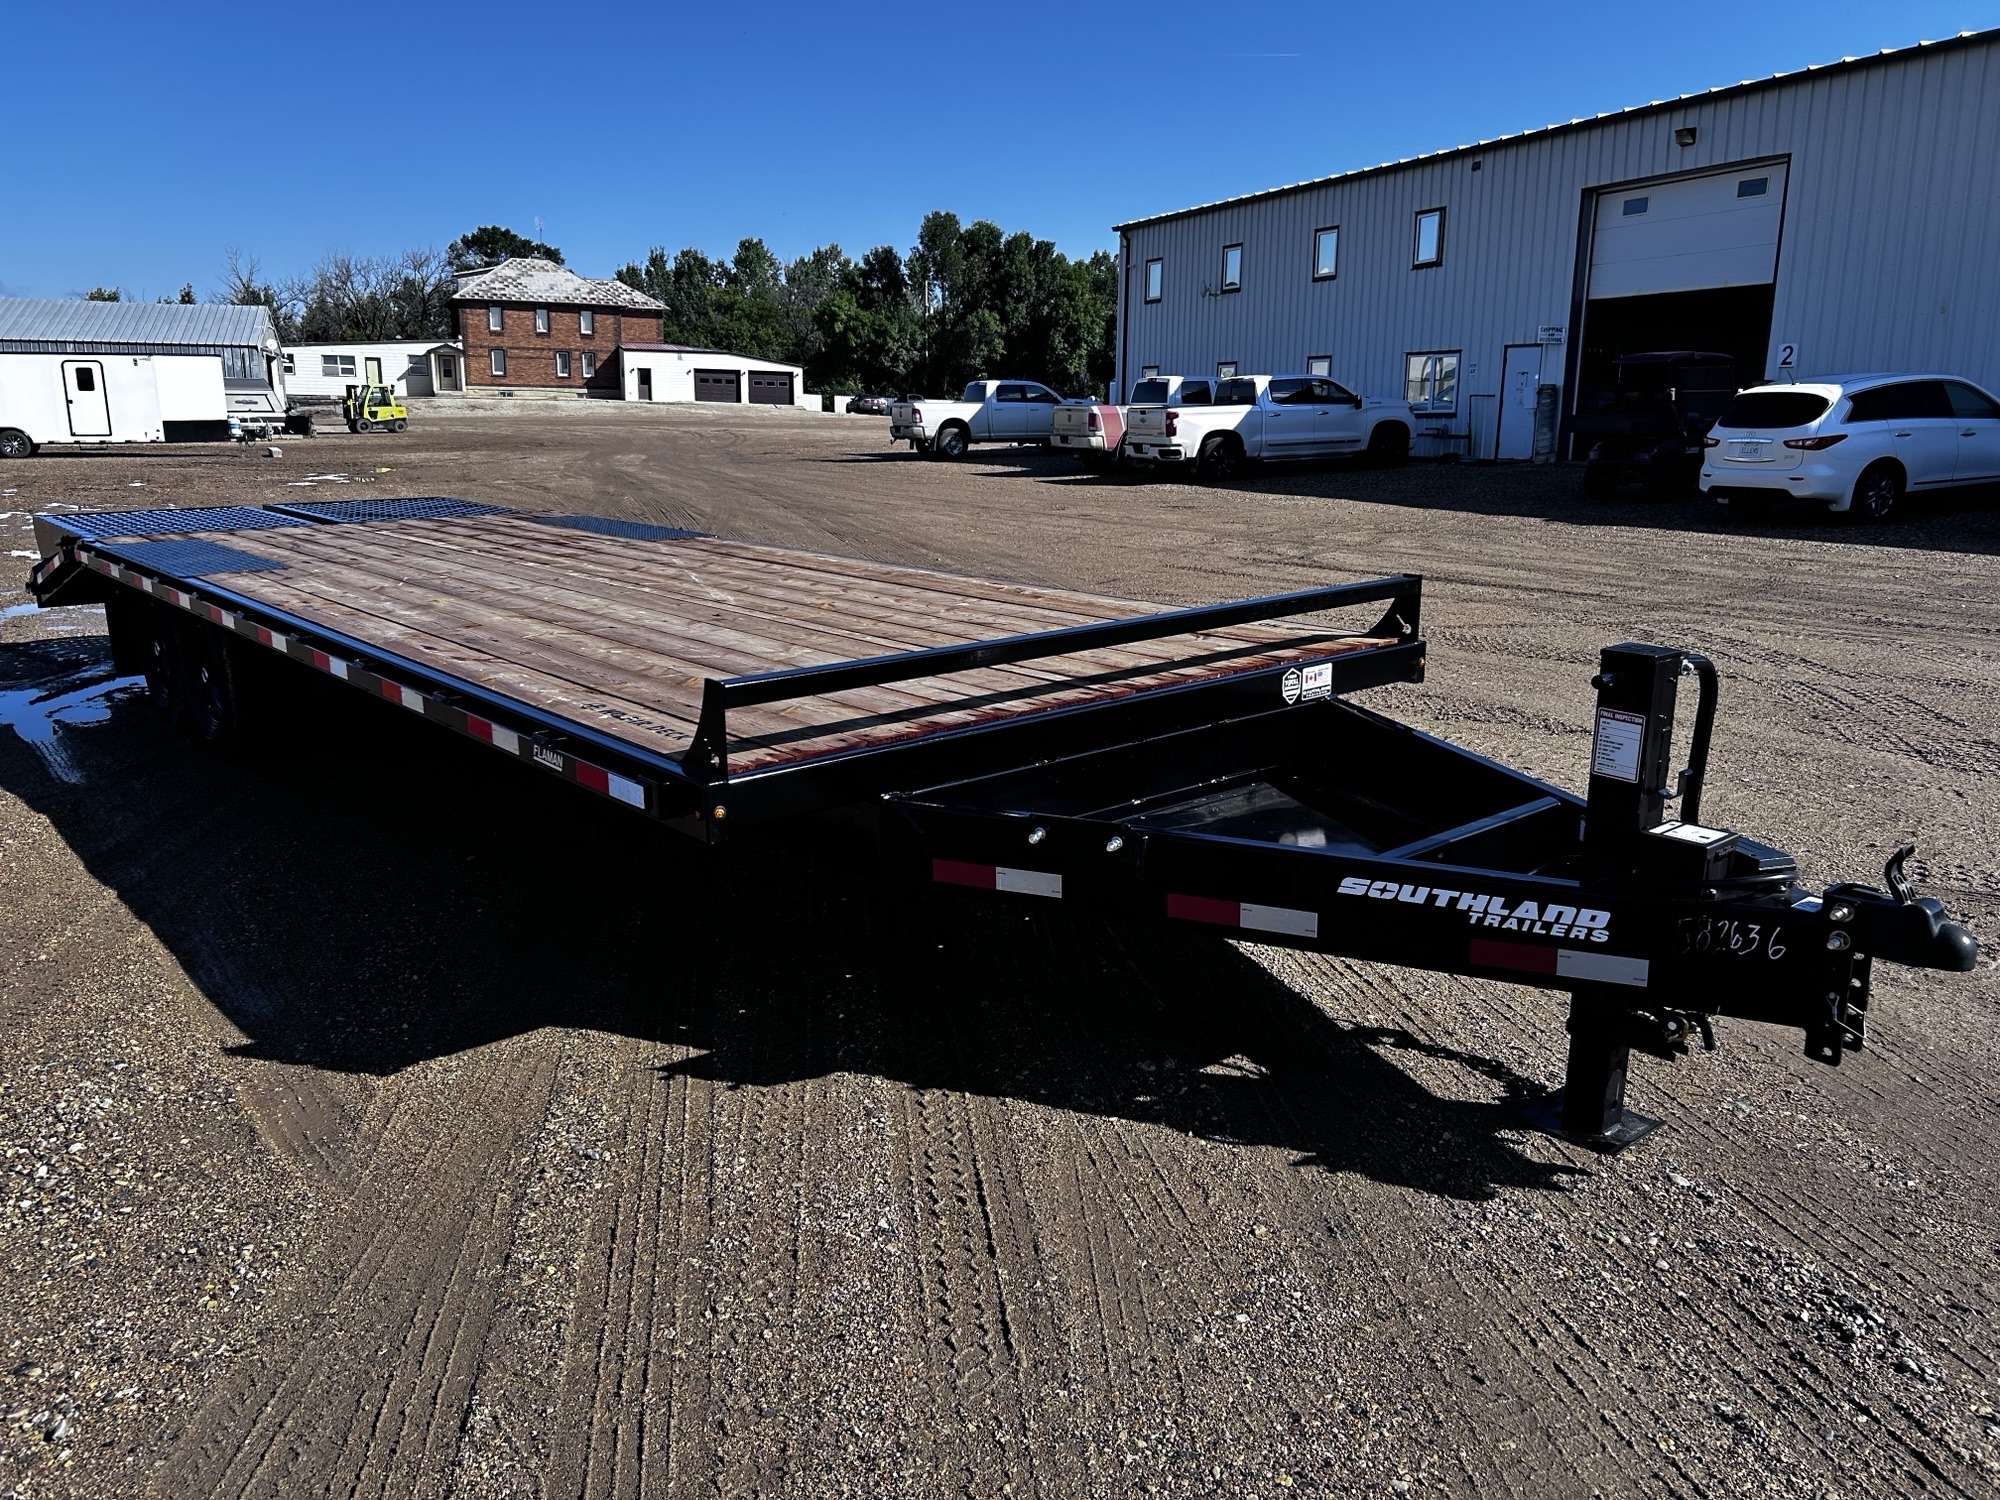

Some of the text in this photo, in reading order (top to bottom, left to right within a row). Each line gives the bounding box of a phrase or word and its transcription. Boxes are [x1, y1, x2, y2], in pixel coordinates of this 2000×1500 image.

[1781, 345, 1794, 366] 2
[1600, 710, 1643, 724] FINAL INSPECTION
[533, 744, 563, 768] FLAMAN
[1337, 876, 1611, 929] SOUTHLAND
[1468, 912, 1610, 942] TRAILERS
